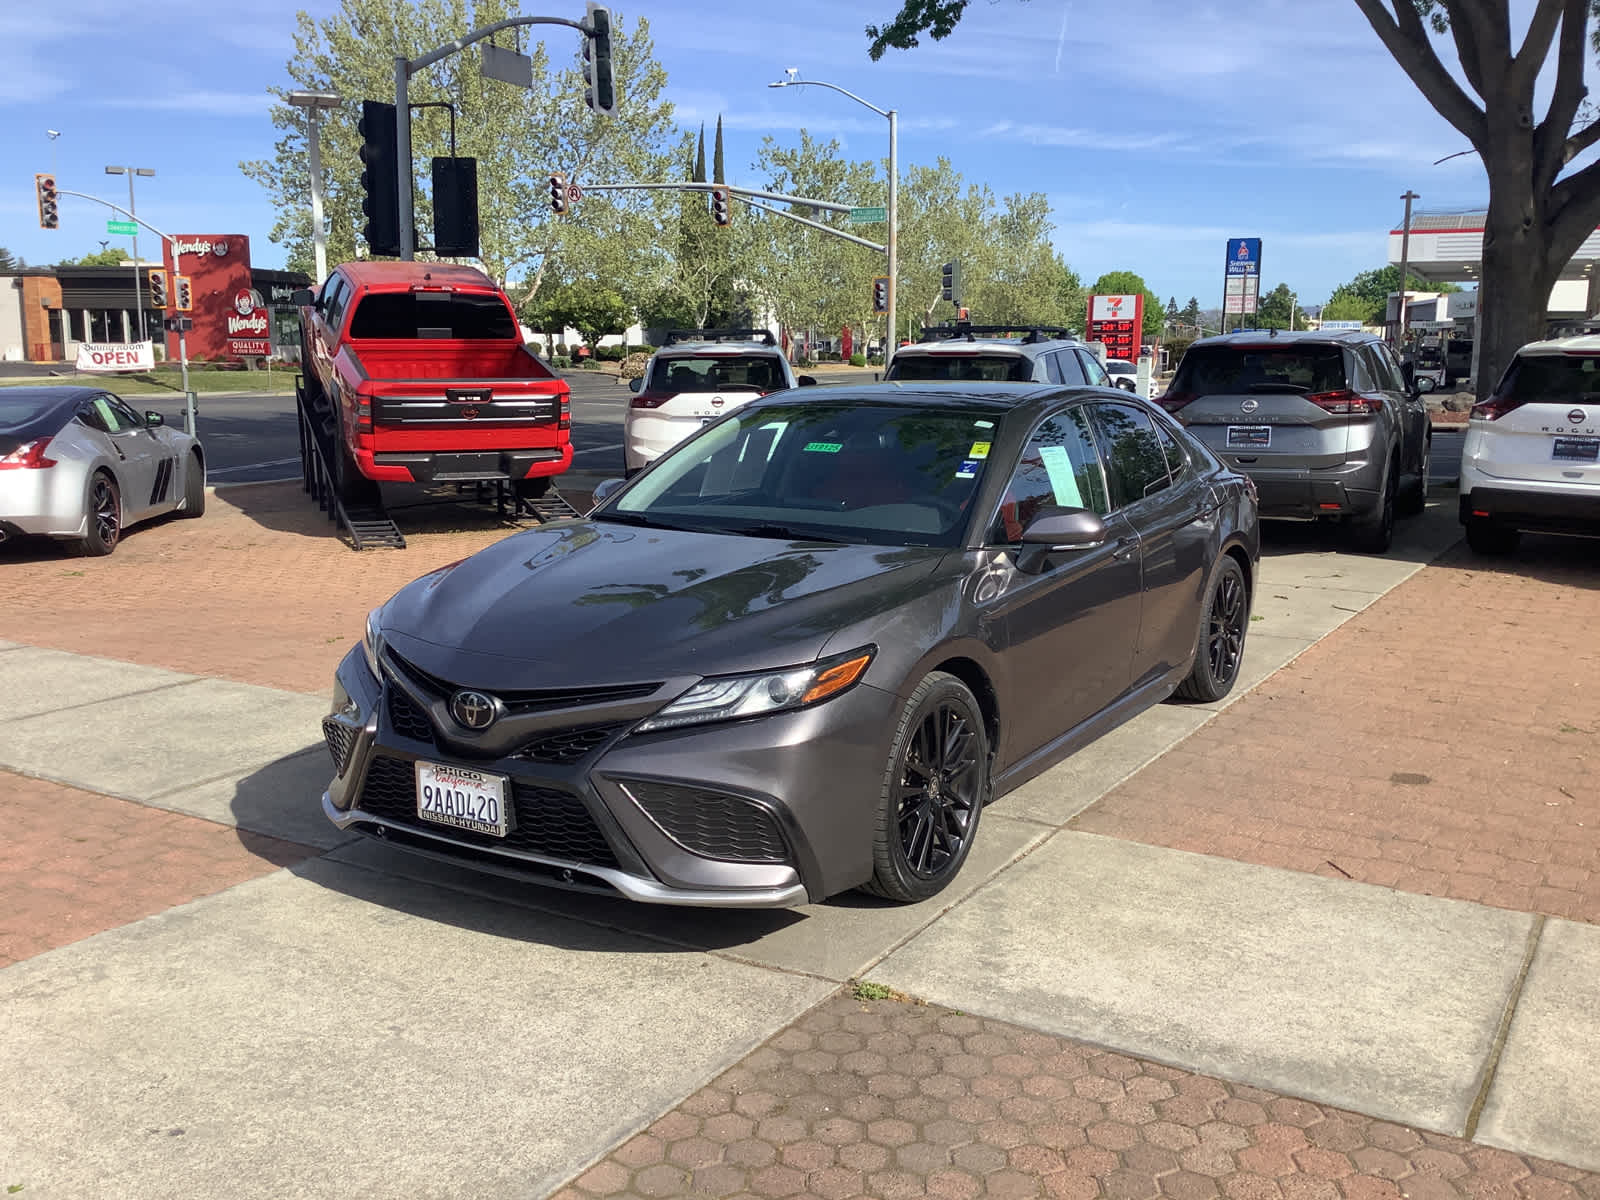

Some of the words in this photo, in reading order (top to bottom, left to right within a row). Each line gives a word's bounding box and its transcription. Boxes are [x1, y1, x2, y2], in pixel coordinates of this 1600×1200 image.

[171, 237, 211, 256] Wendy's
[228, 313, 267, 334] Wendy's
[232, 341, 265, 349] QUALITY
[92, 351, 139, 365] OPEN
[1541, 426, 1595, 434] ROGU
[436, 766, 481, 781] CHICO
[423, 785, 499, 823] 9AAD420
[422, 810, 500, 834] NISSAN-HYUNDAI
